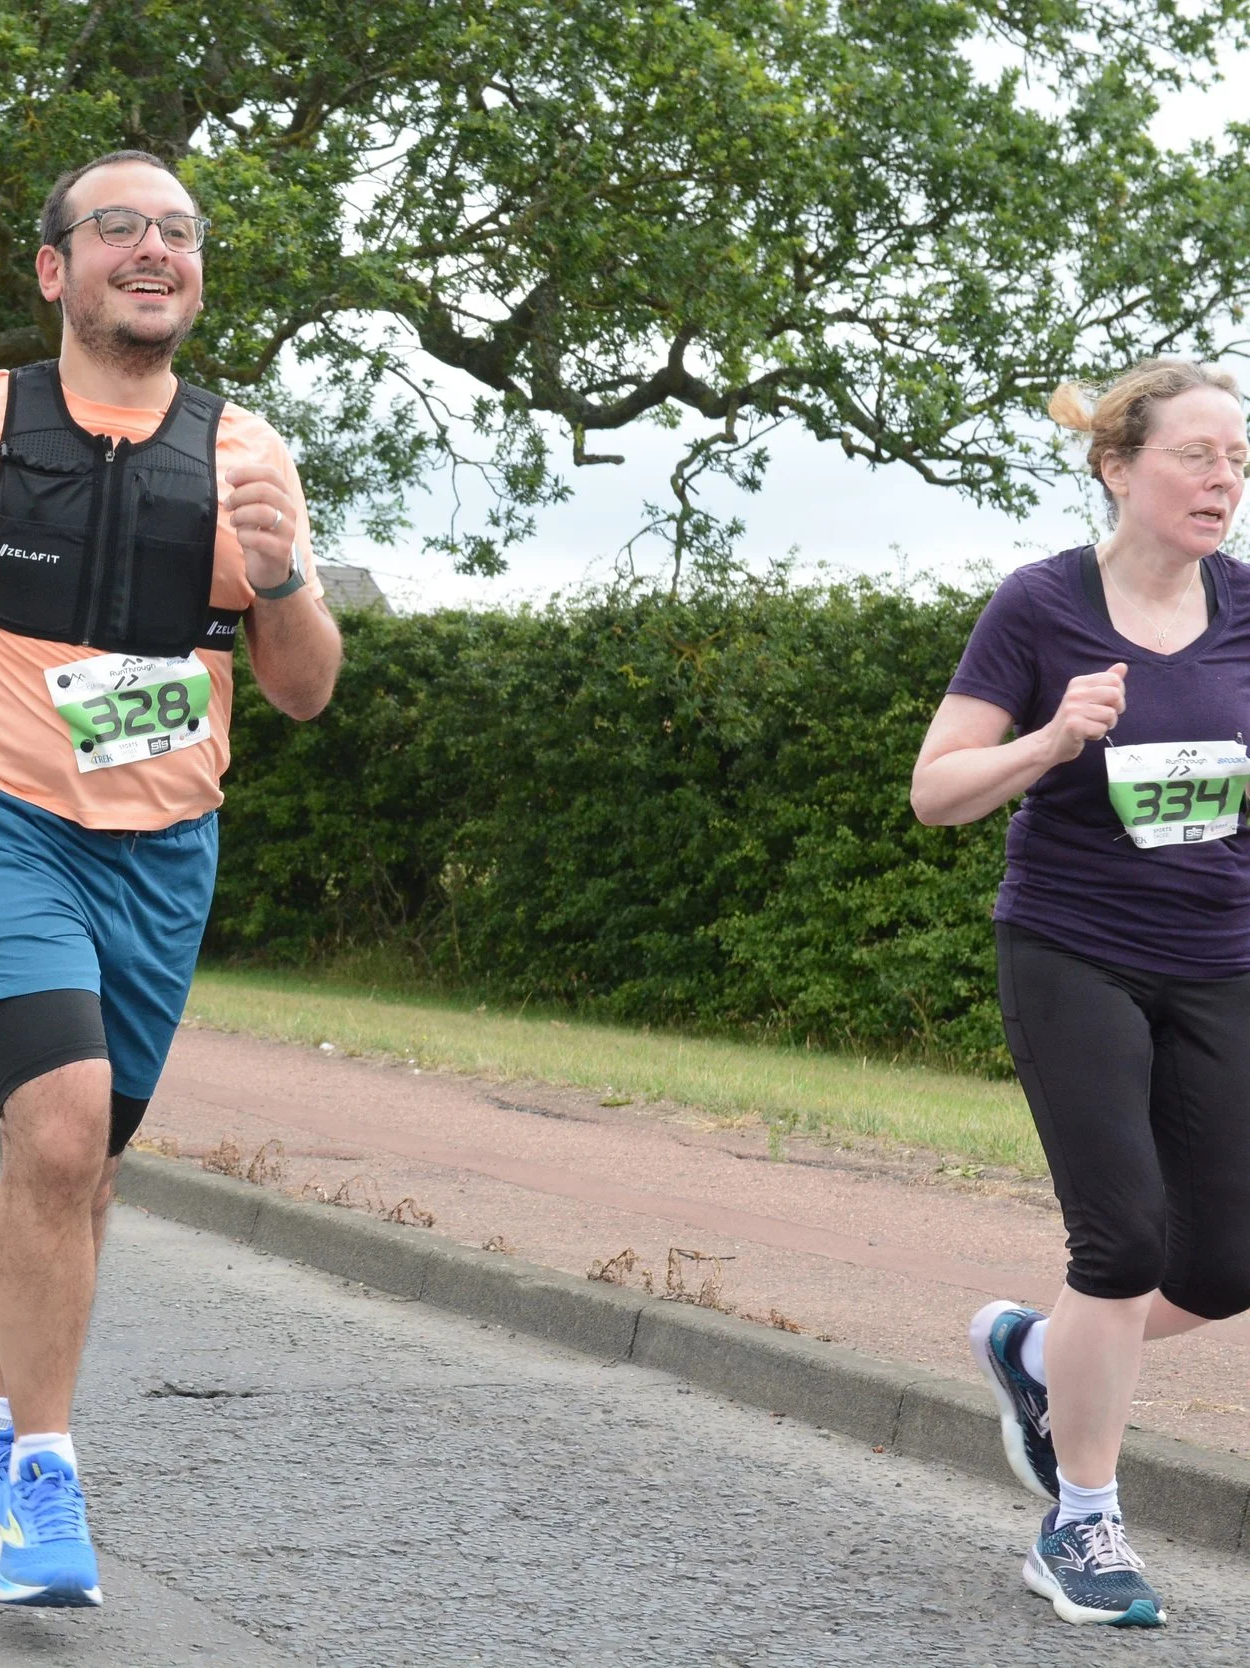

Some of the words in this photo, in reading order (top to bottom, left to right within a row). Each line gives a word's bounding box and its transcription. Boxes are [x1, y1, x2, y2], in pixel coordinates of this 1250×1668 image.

[6, 546, 60, 564] ZELAFIT
[109, 663, 156, 677] RunThrough
[82, 682, 191, 743] 328
[93, 754, 114, 764] TREK
[1165, 758, 1207, 766] RunThrough
[1133, 779, 1228, 825] 334
